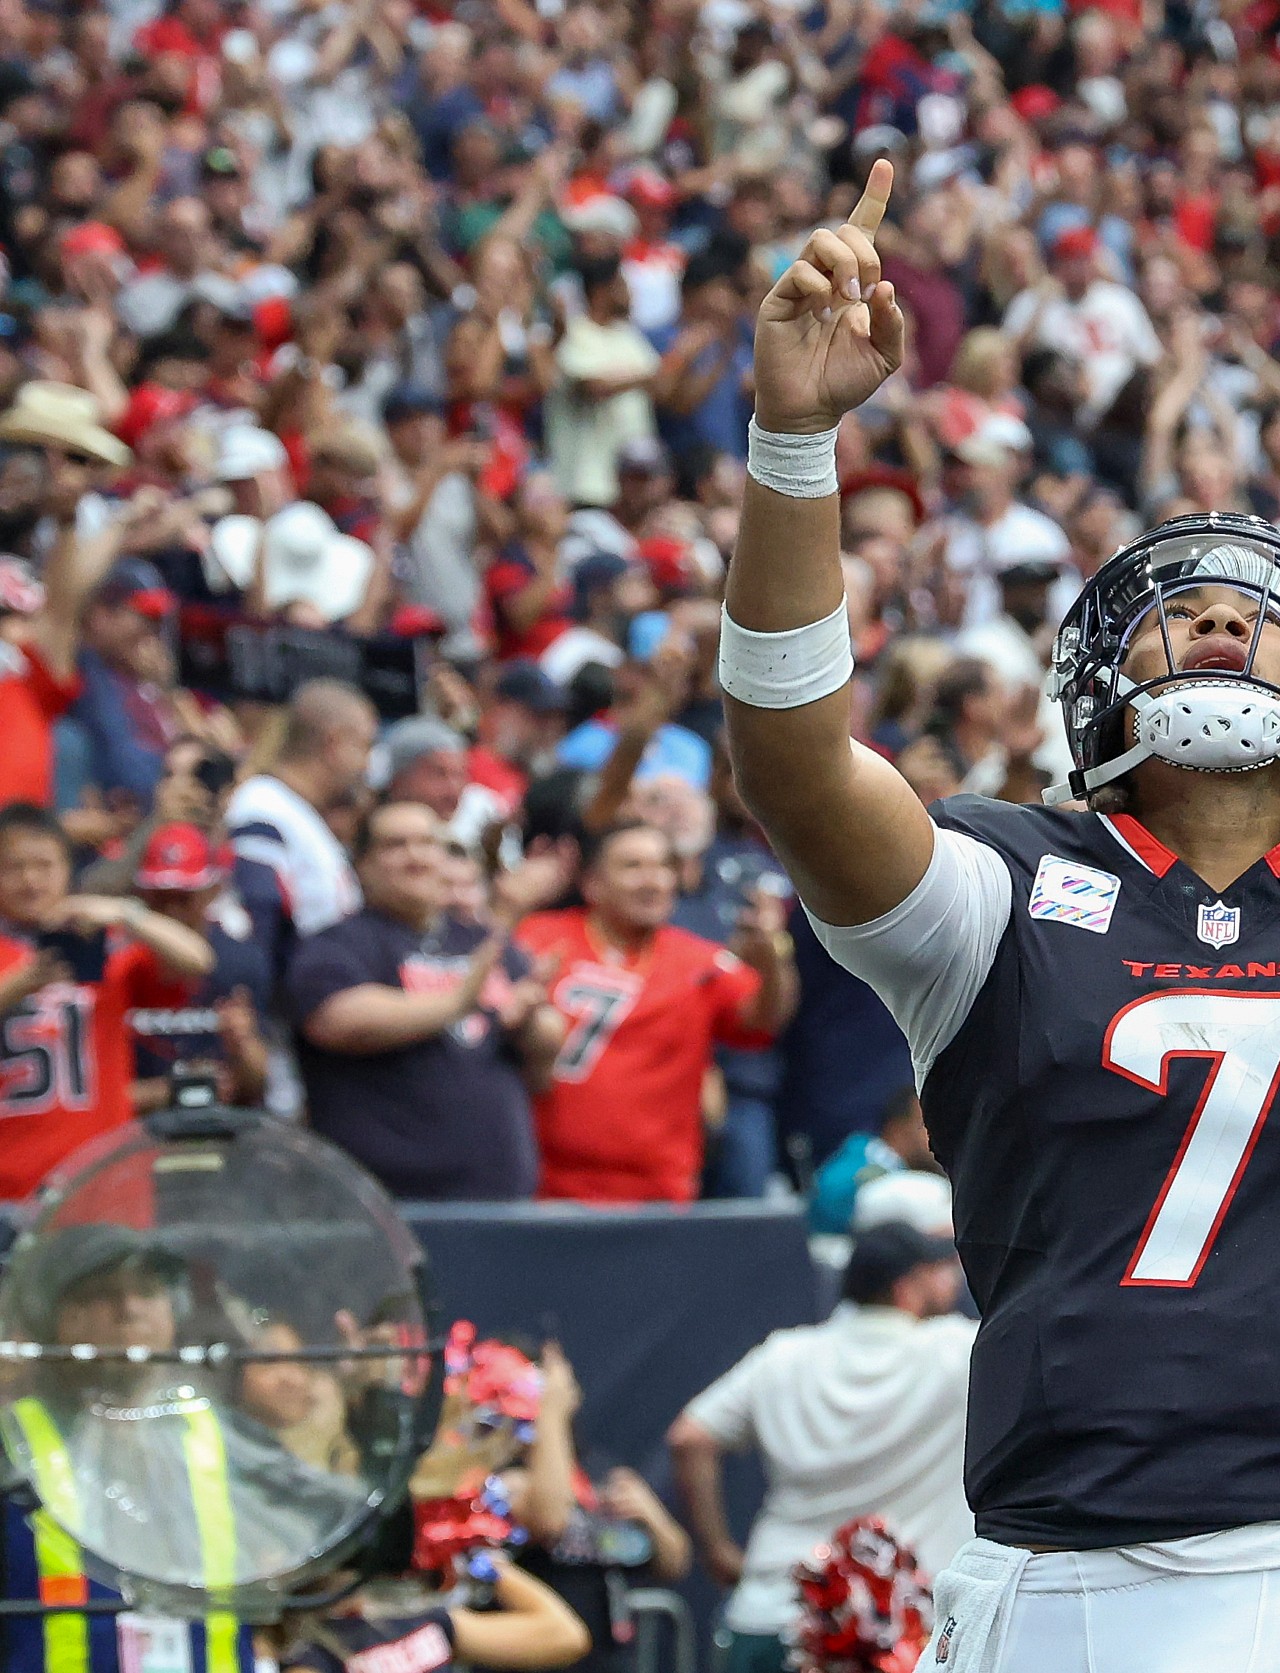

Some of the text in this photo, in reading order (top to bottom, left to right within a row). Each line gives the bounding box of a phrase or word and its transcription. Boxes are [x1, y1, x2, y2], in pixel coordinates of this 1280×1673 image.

[1040, 862, 1114, 913] C
[1203, 921, 1233, 940] NFL
[553, 968, 644, 1085] 7
